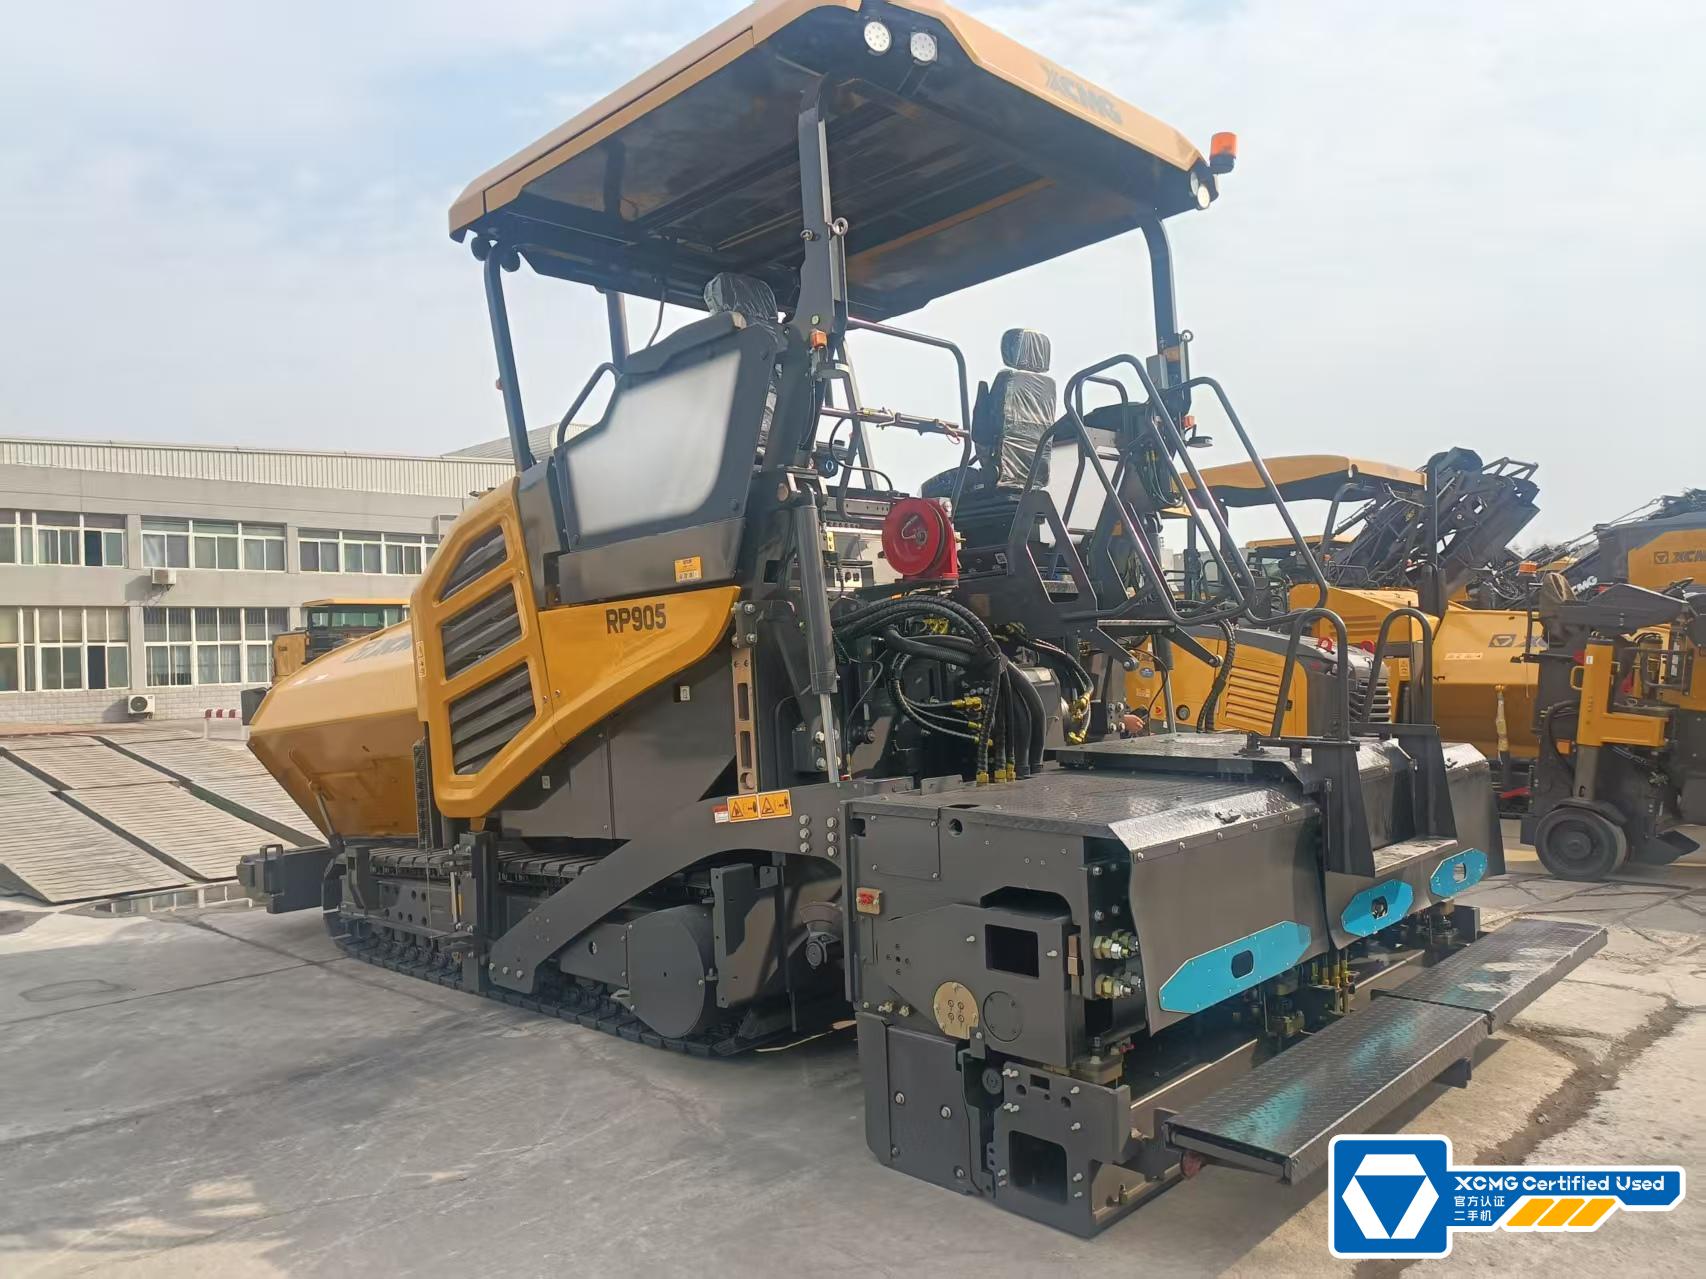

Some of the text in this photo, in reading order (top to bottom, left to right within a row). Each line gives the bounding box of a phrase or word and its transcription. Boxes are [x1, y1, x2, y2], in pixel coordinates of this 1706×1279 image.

[1671, 551, 1706, 563] XCM
[1570, 575, 1598, 596] CMG
[606, 603, 666, 634] RP905
